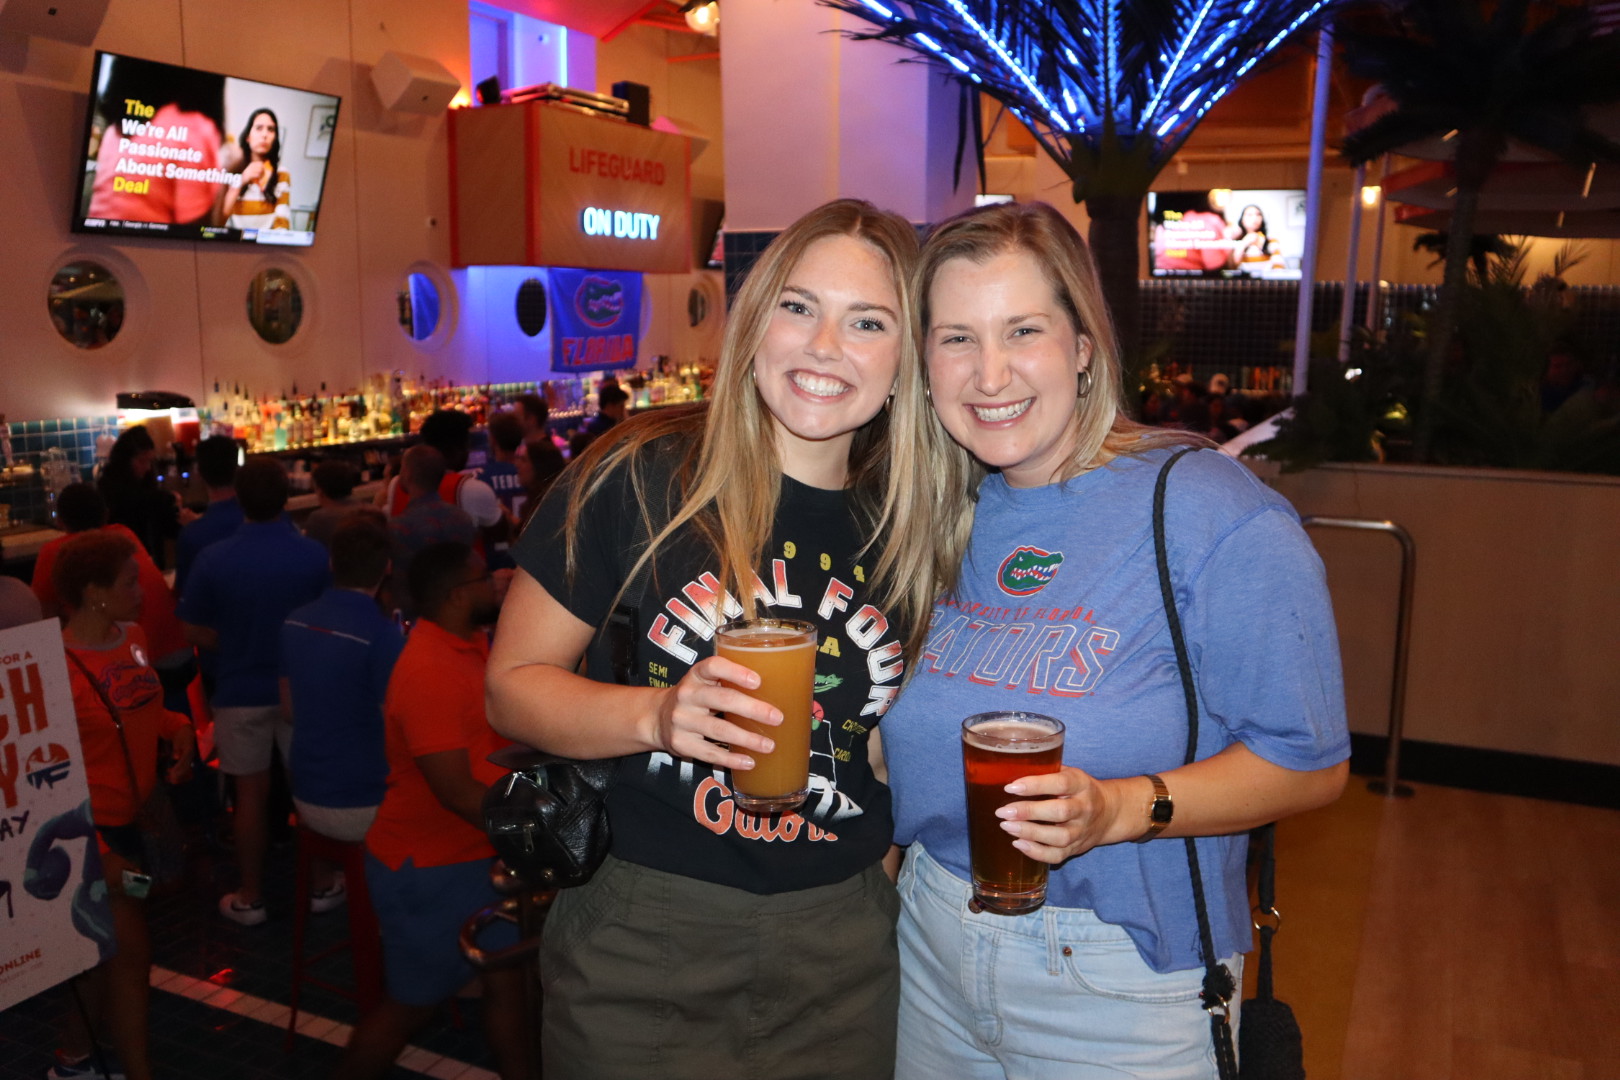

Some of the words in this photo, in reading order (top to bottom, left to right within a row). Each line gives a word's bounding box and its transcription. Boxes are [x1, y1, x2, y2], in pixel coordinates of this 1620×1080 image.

[125, 98, 155, 119] The
[121, 118, 164, 138] We're
[166, 126, 188, 142] All
[118, 138, 203, 163] Passionate
[115, 158, 163, 178] About
[165, 165, 242, 187] Something
[569, 147, 666, 186] LIFEGUARD
[113, 177, 149, 195] Deal
[583, 207, 611, 236] ON
[614, 210, 660, 240] DUTY
[562, 334, 634, 366] FLORIDA
[783, 541, 865, 583] 994
[0, 652, 20, 666] OR
[818, 577, 904, 717] FOUR
[648, 661, 668, 678] SEMI
